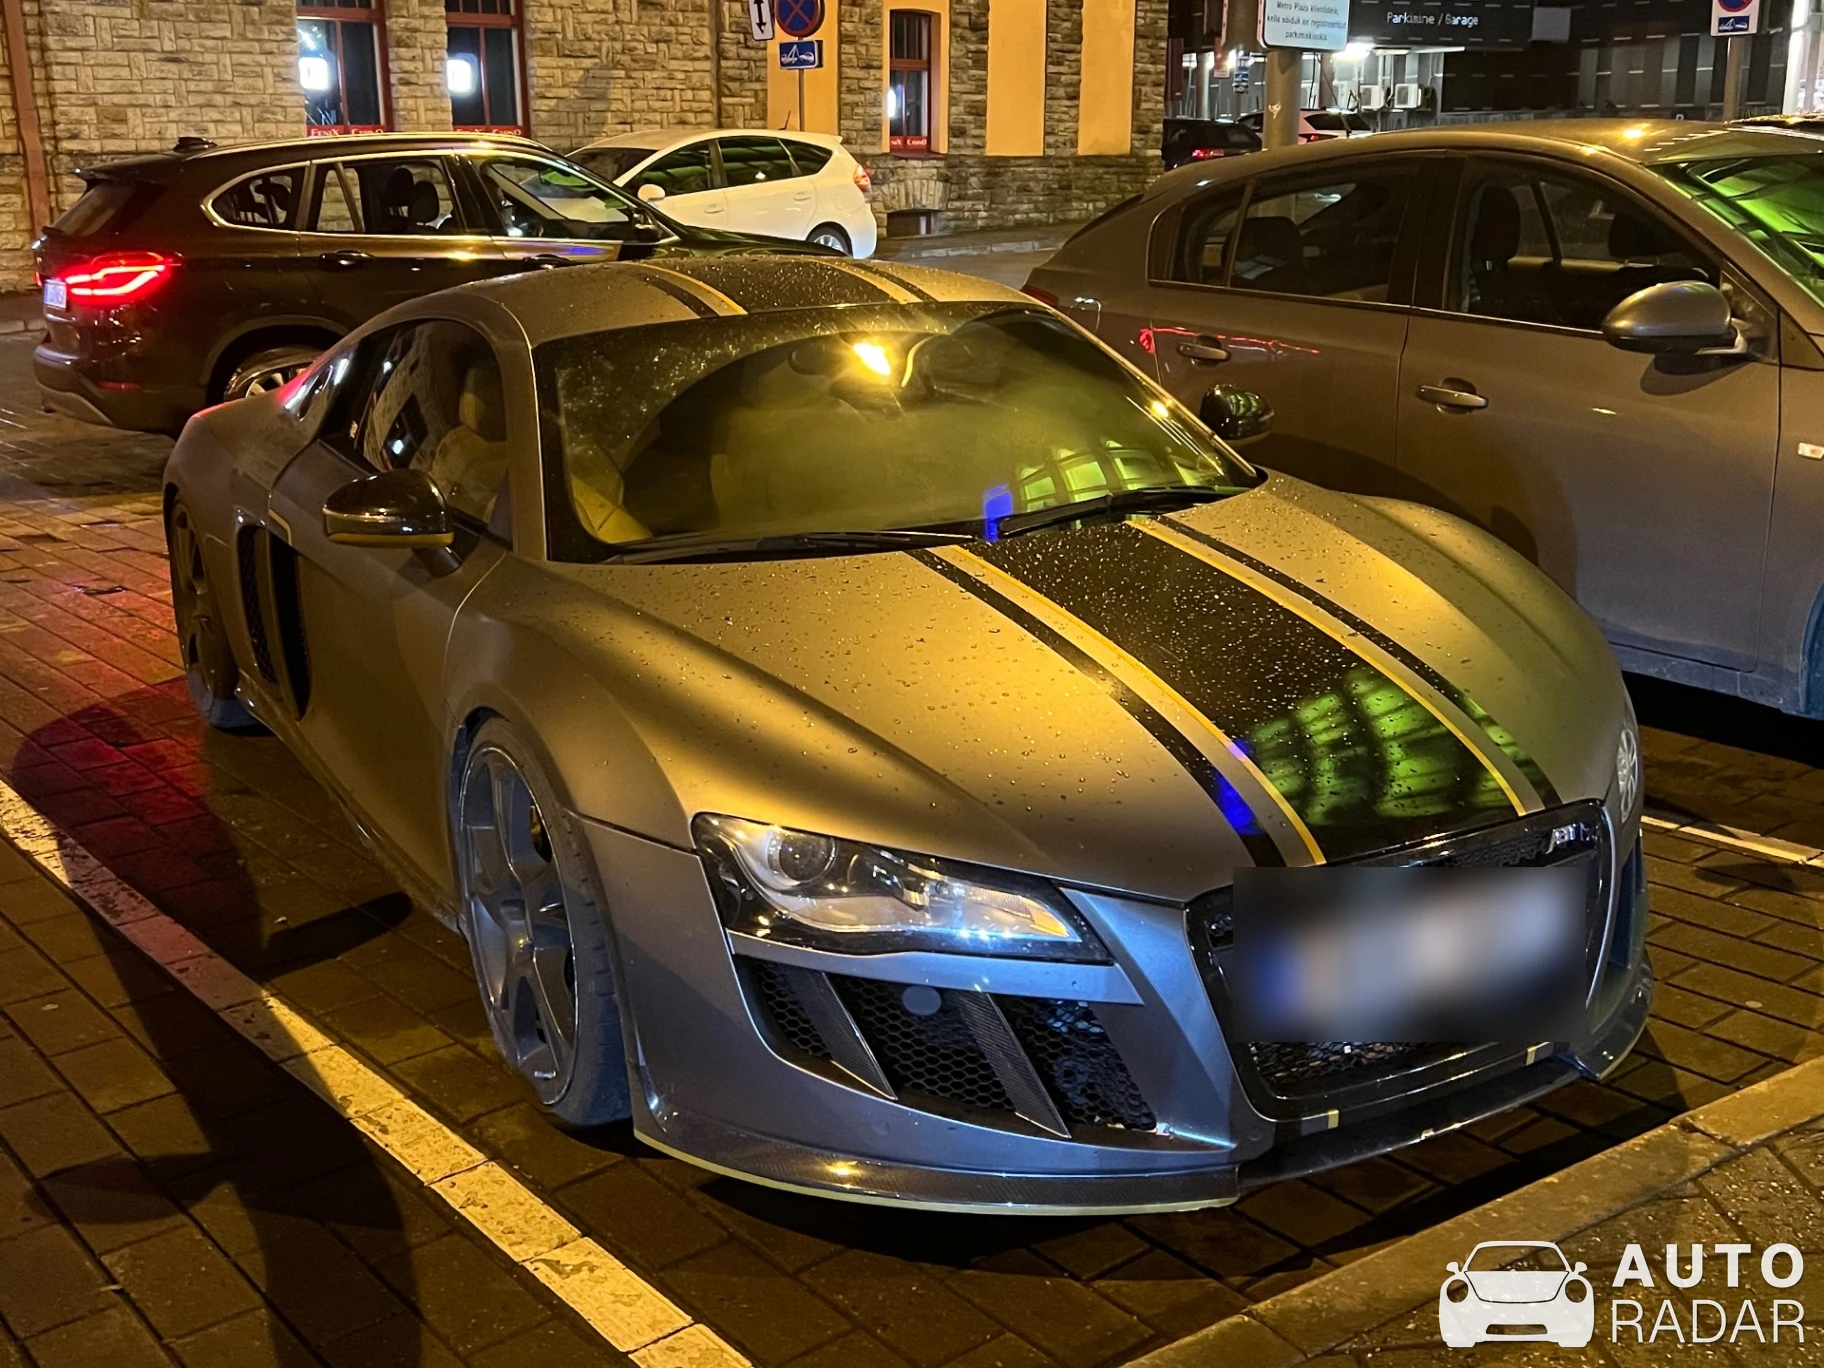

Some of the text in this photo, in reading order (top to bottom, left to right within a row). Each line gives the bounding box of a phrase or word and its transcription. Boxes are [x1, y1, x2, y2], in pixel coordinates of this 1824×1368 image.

[1277, 1, 1293, 10] Metro
[1294, 3, 1309, 12] Plaza
[1386, 11, 1435, 24] Parkimine
[1445, 13, 1479, 28] Garage
